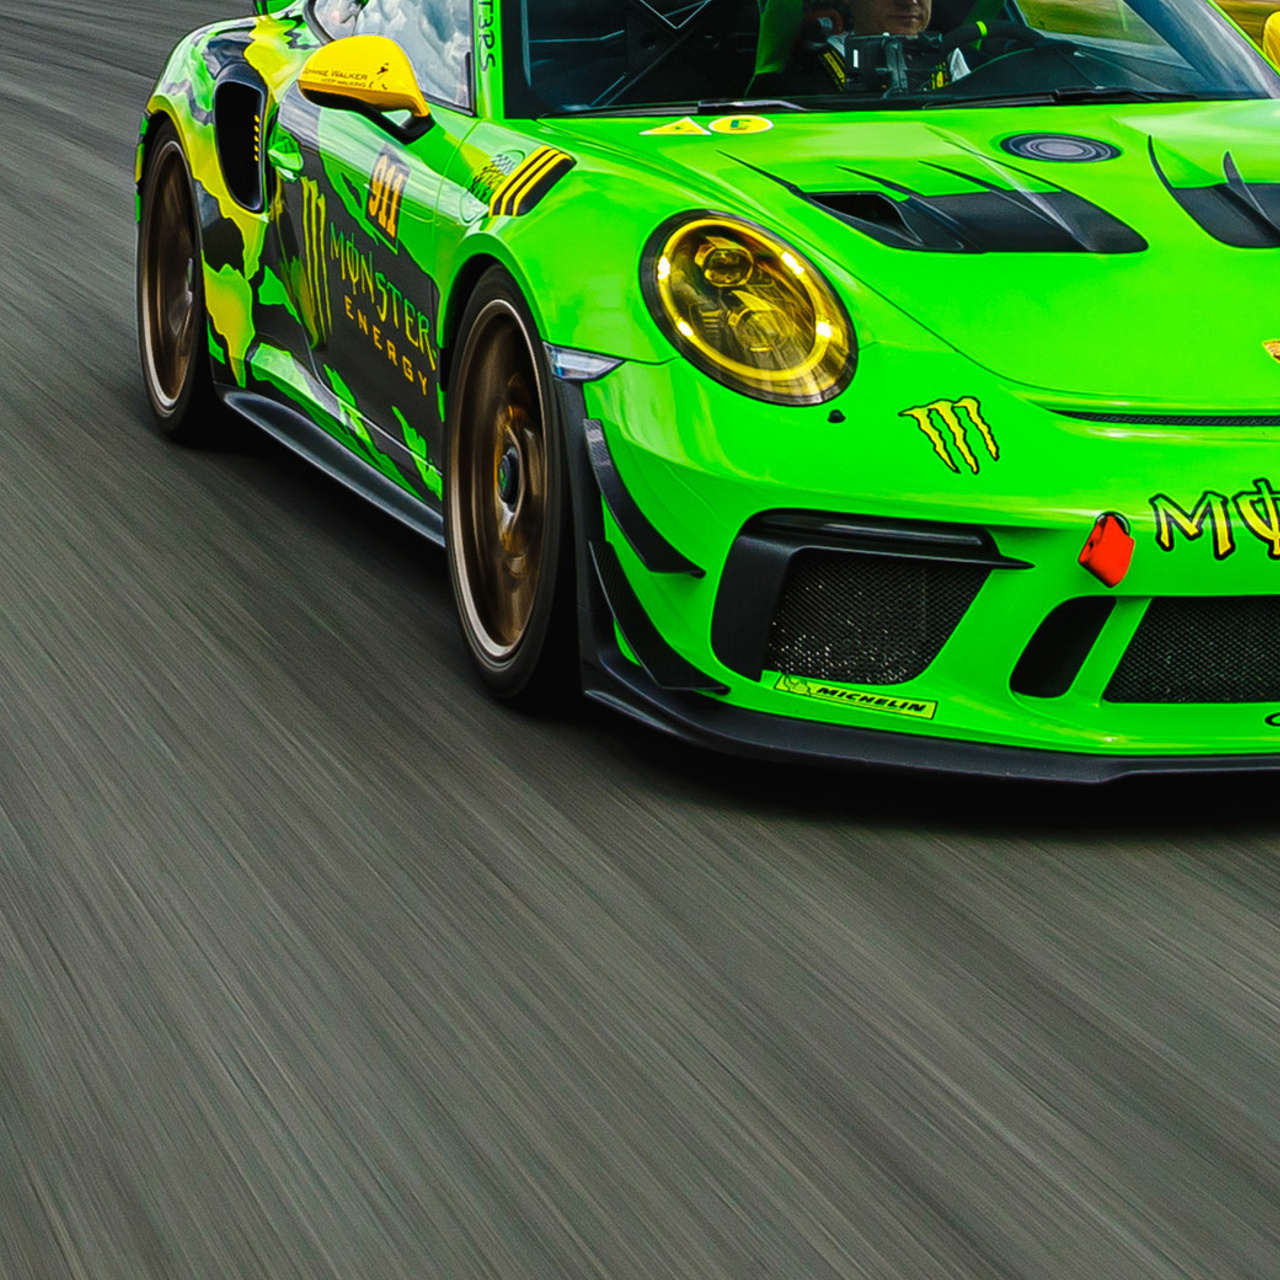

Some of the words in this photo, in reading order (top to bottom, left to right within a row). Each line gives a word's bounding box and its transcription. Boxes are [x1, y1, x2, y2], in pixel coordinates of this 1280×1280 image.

[330, 69, 368, 80] WALKER
[368, 154, 405, 238] 911
[330, 221, 436, 371] MONSTER
[344, 295, 428, 395] ENERGY
[817, 687, 926, 712] MICHELIN
